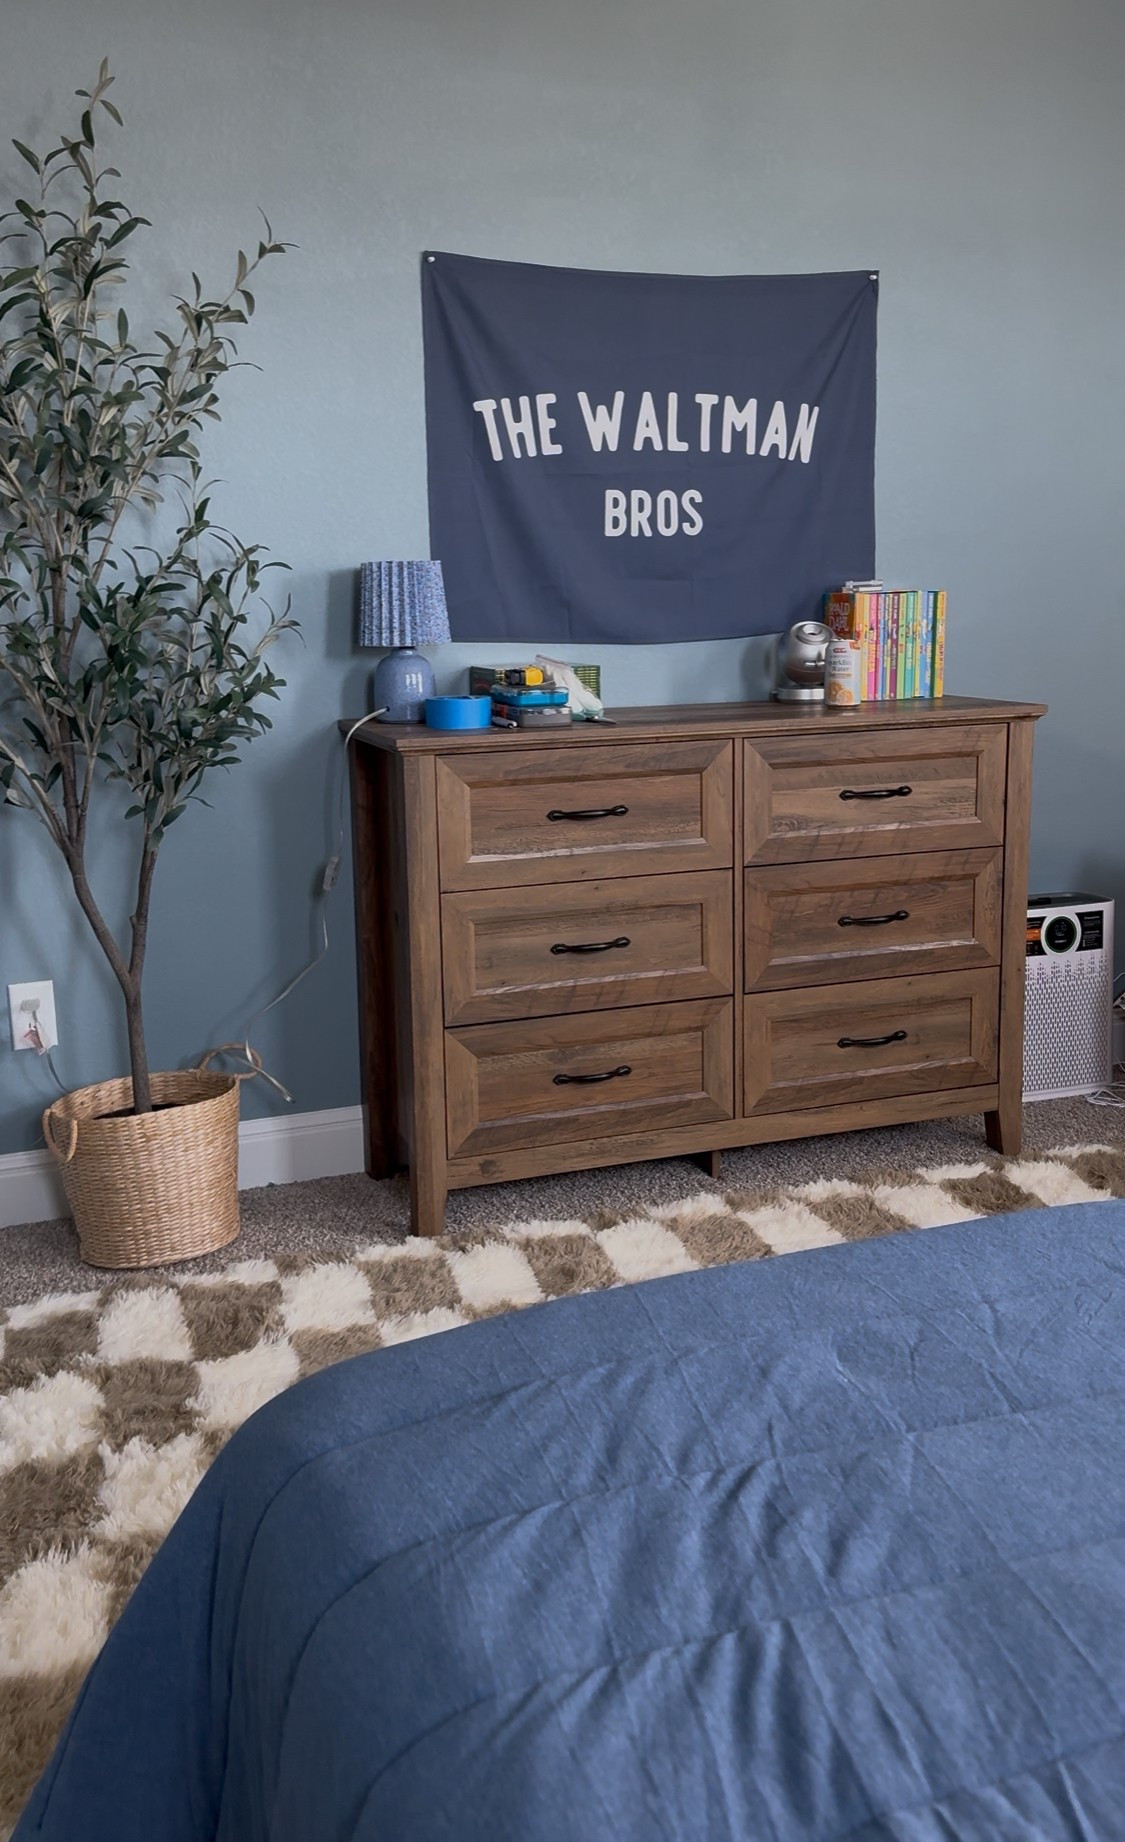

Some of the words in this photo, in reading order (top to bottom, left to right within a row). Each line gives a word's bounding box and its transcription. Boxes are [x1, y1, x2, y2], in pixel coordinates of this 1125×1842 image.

[472, 390, 563, 462] THE
[576, 390, 820, 464] WALTMAN
[604, 489, 704, 537] BROS
